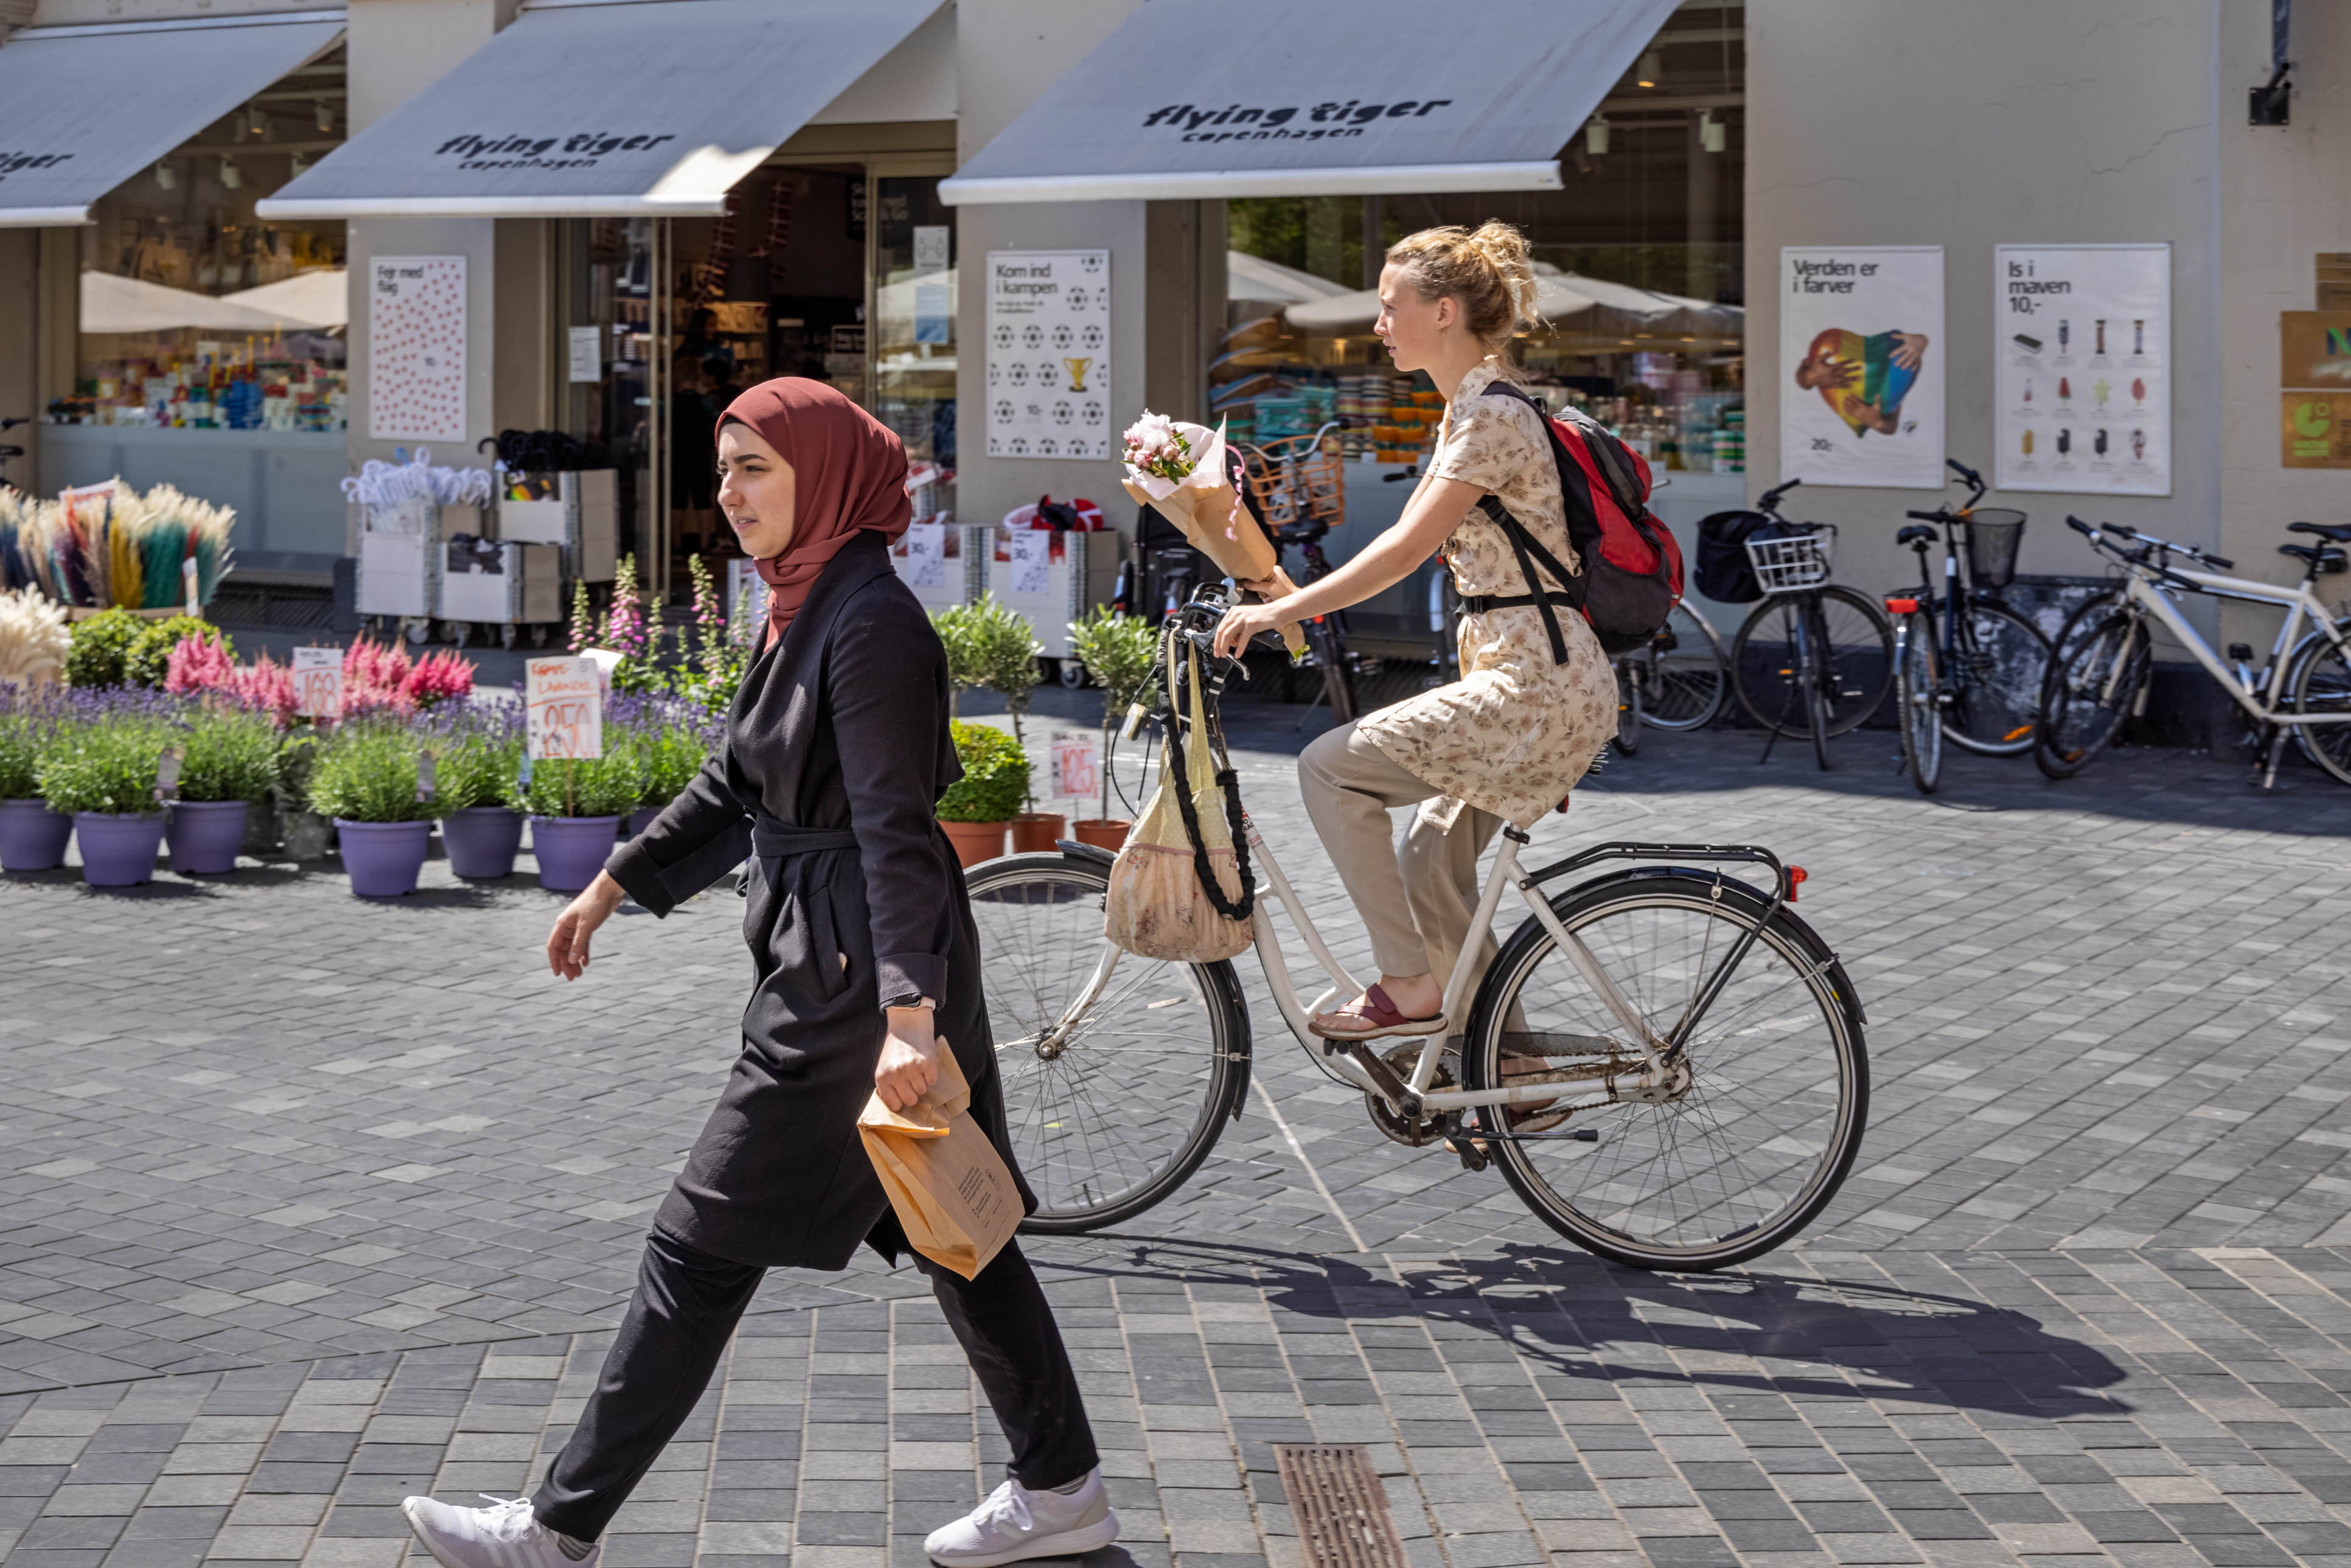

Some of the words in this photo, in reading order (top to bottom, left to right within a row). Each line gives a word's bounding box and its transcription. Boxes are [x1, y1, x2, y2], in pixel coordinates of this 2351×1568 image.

[1142, 104, 1300, 131] flying
[1310, 99, 1454, 125] tiger
[1181, 128, 1365, 143] copenhagen
[435, 134, 559, 159] flying
[563, 132, 676, 157] tiger
[458, 158, 598, 171] copenhagen
[996, 263, 1027, 278] Kom
[1030, 262, 1051, 278] ind
[1792, 259, 1855, 276] Verden
[1860, 263, 1879, 276] er
[2008, 260, 2023, 277] Is
[2029, 260, 2034, 277] i
[995, 280, 1000, 294] i
[1003, 280, 1058, 298] kampen
[1793, 276, 1799, 293] i
[1803, 276, 1855, 293] farver
[2008, 280, 2071, 294] maven
